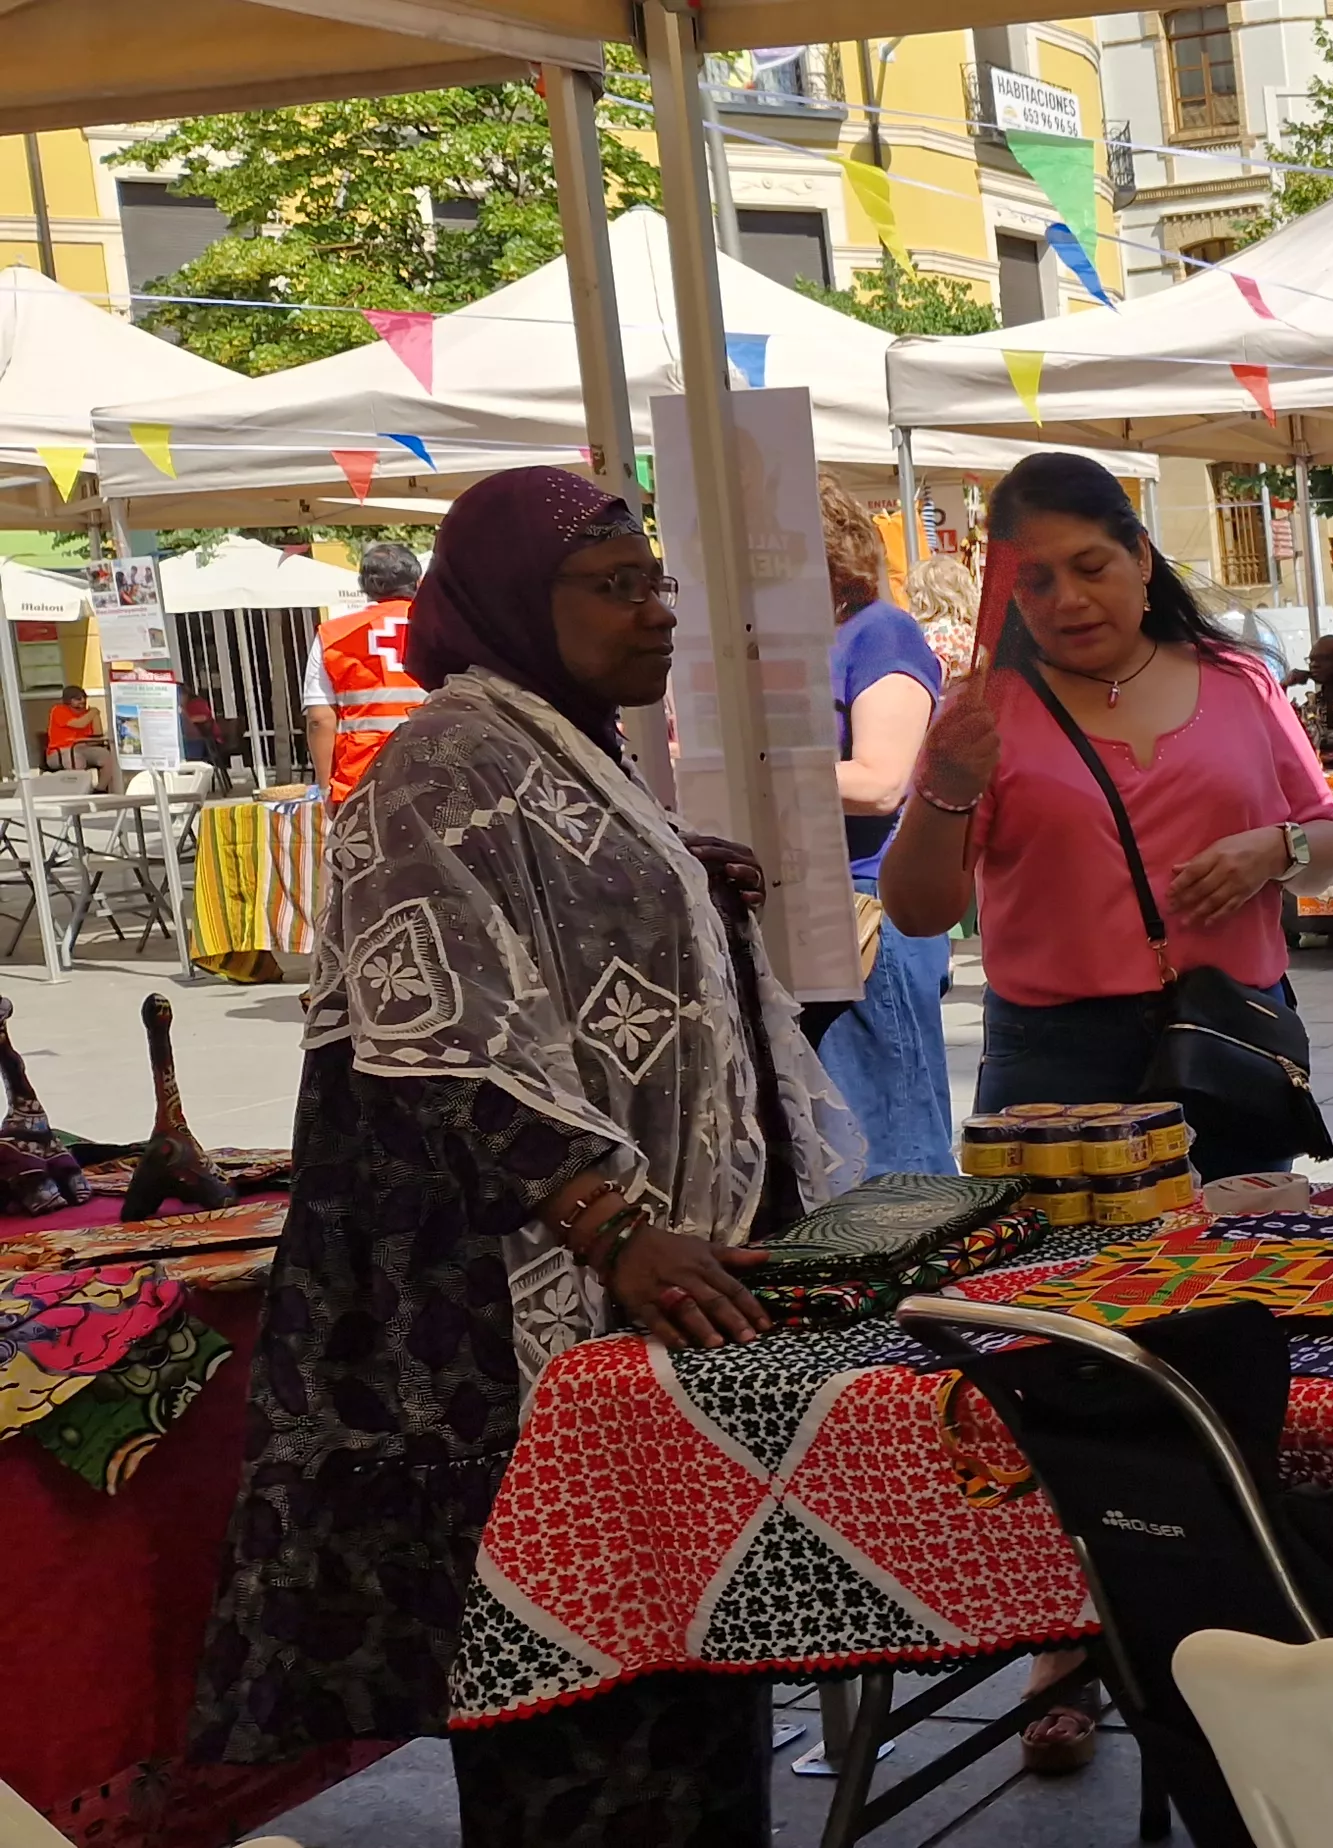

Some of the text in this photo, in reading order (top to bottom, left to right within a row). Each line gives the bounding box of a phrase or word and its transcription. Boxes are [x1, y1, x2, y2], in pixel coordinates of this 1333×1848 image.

[997, 75, 1077, 117] HABITACIONES
[1023, 106, 1040, 125] 653
[21, 602, 64, 613] Mahou
[1119, 1518, 1186, 1538] ROLSER
